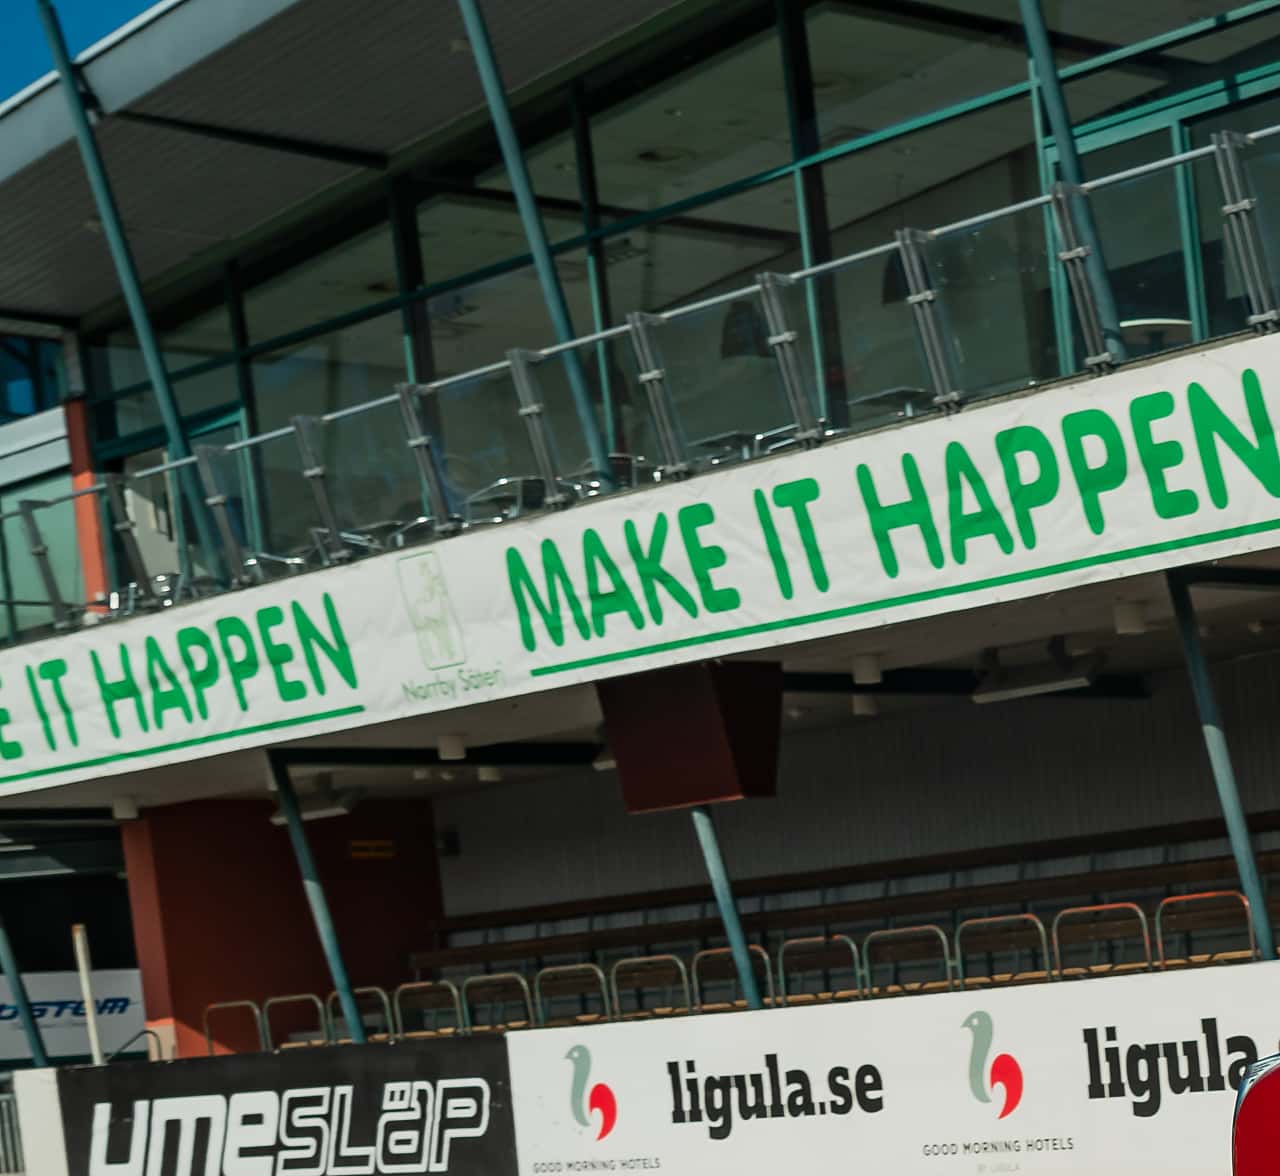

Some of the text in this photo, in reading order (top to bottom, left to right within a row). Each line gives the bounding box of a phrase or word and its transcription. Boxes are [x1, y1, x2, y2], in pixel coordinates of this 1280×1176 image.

[505, 502, 742, 653] MAKE
[754, 477, 830, 601] IT
[25, 658, 79, 752] IT
[90, 591, 358, 738] HAPPEN
[666, 1053, 884, 1140] ligula.se
[532, 1162, 563, 1174] GOOD
[620, 1157, 661, 1171] HOTELS
[922, 1137, 1074, 1156] GOOD MORNING HOTELS
